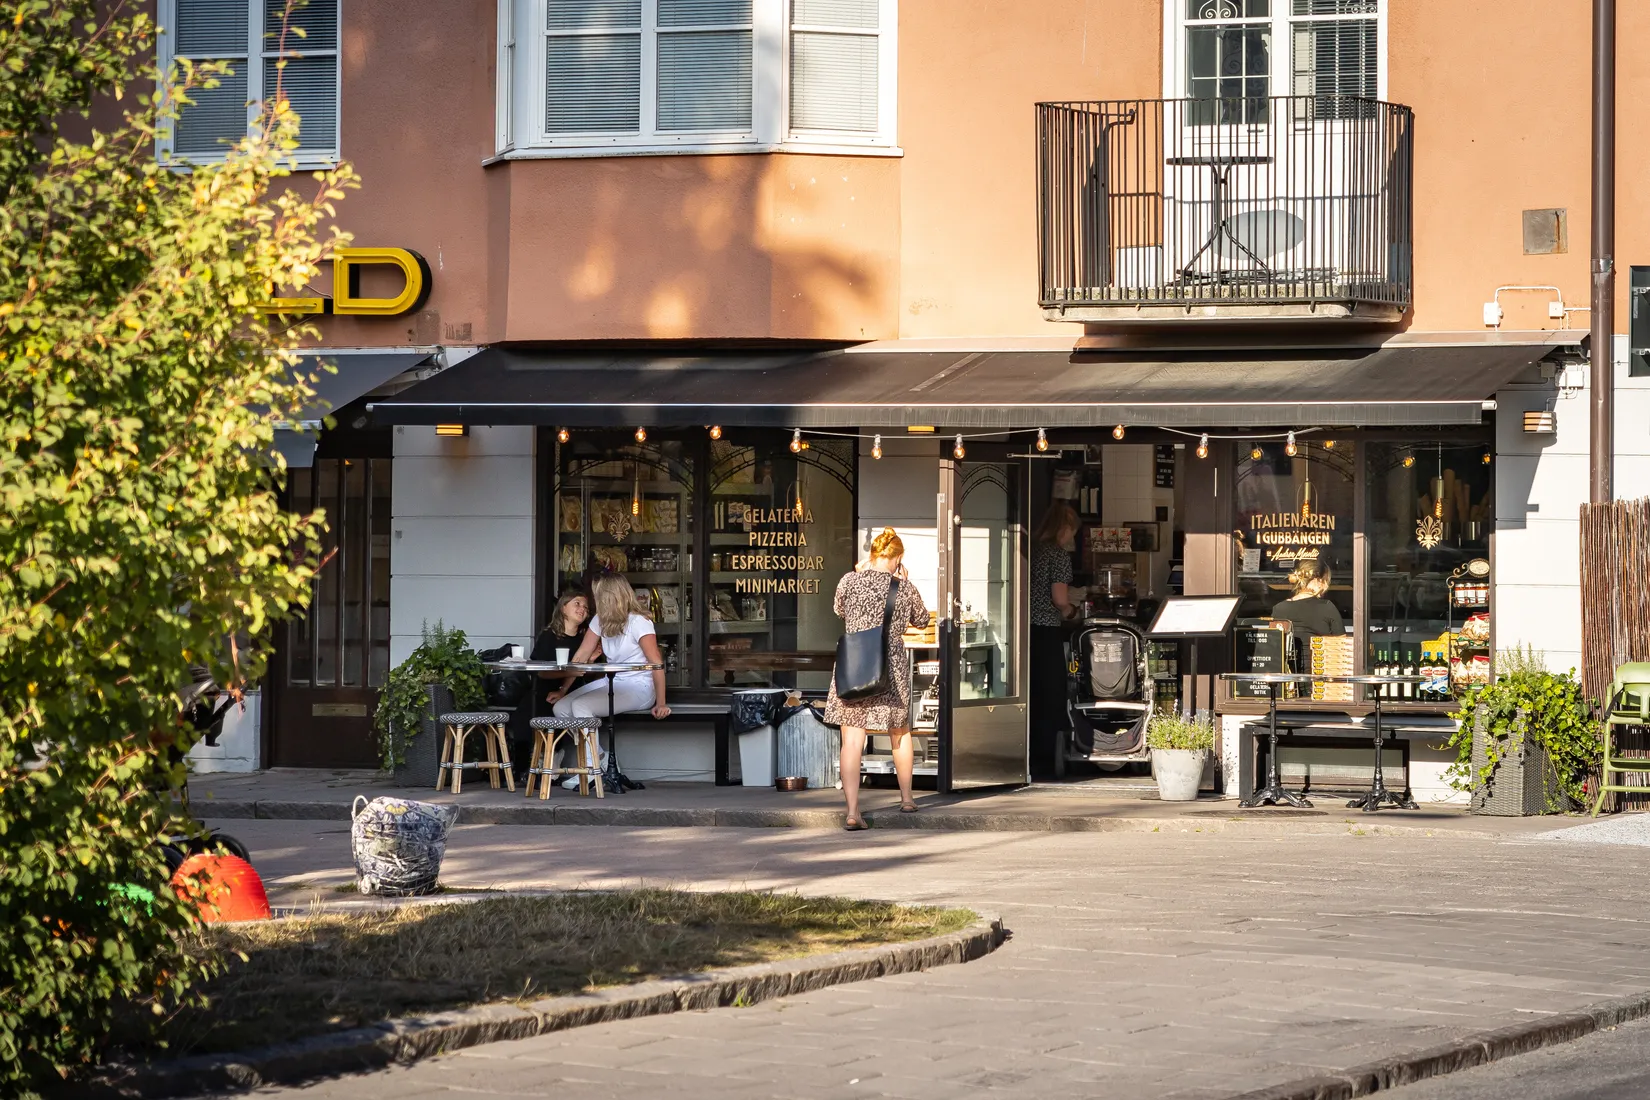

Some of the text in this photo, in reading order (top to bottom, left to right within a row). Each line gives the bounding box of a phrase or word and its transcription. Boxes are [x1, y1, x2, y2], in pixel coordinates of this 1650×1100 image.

[743, 508, 814, 523] GELATERIA
[1251, 512, 1336, 530] ITALIENAREN
[749, 532, 807, 547] PIZZERIA
[1256, 530, 1330, 545] I GUBBÄNGEN
[732, 555, 824, 570] ESPRESSOBAR
[735, 578, 821, 594] MINIMARKET
